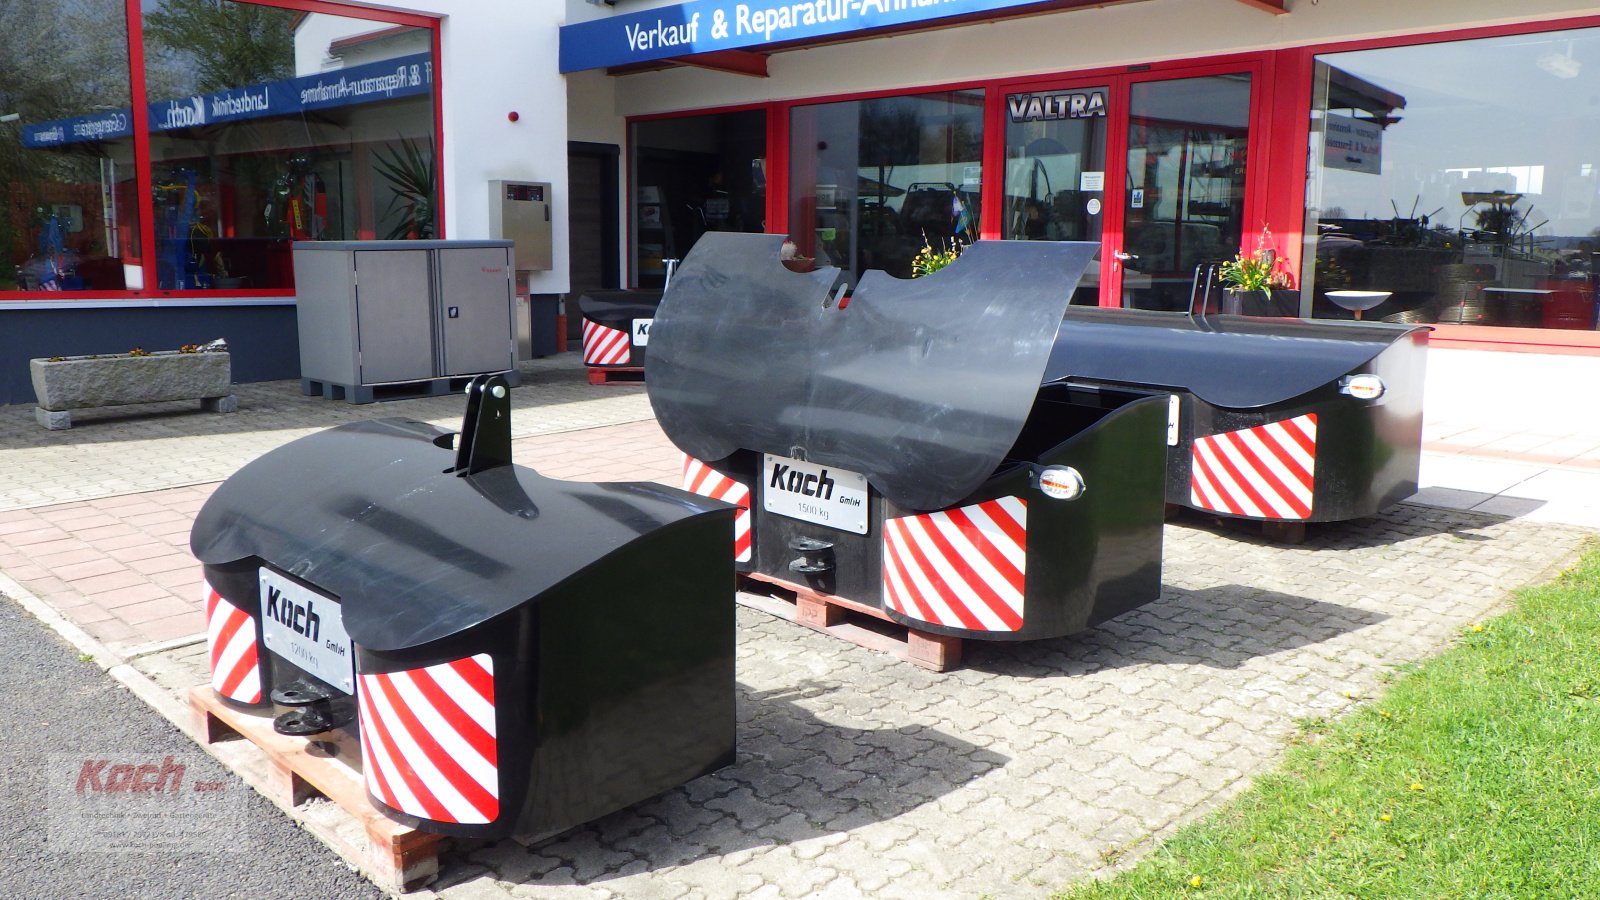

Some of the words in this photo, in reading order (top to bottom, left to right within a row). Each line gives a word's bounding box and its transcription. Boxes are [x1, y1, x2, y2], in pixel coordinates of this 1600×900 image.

[625, 12, 700, 52] Verkauf
[711, 9, 729, 39] &
[1006, 91, 1108, 124] VALTRA
[637, 323, 650, 335] K
[770, 463, 835, 501] Koch
[839, 495, 861, 507] GmbH
[798, 502, 817, 516] 1500
[819, 505, 830, 520] kg
[267, 585, 320, 642] Koch
